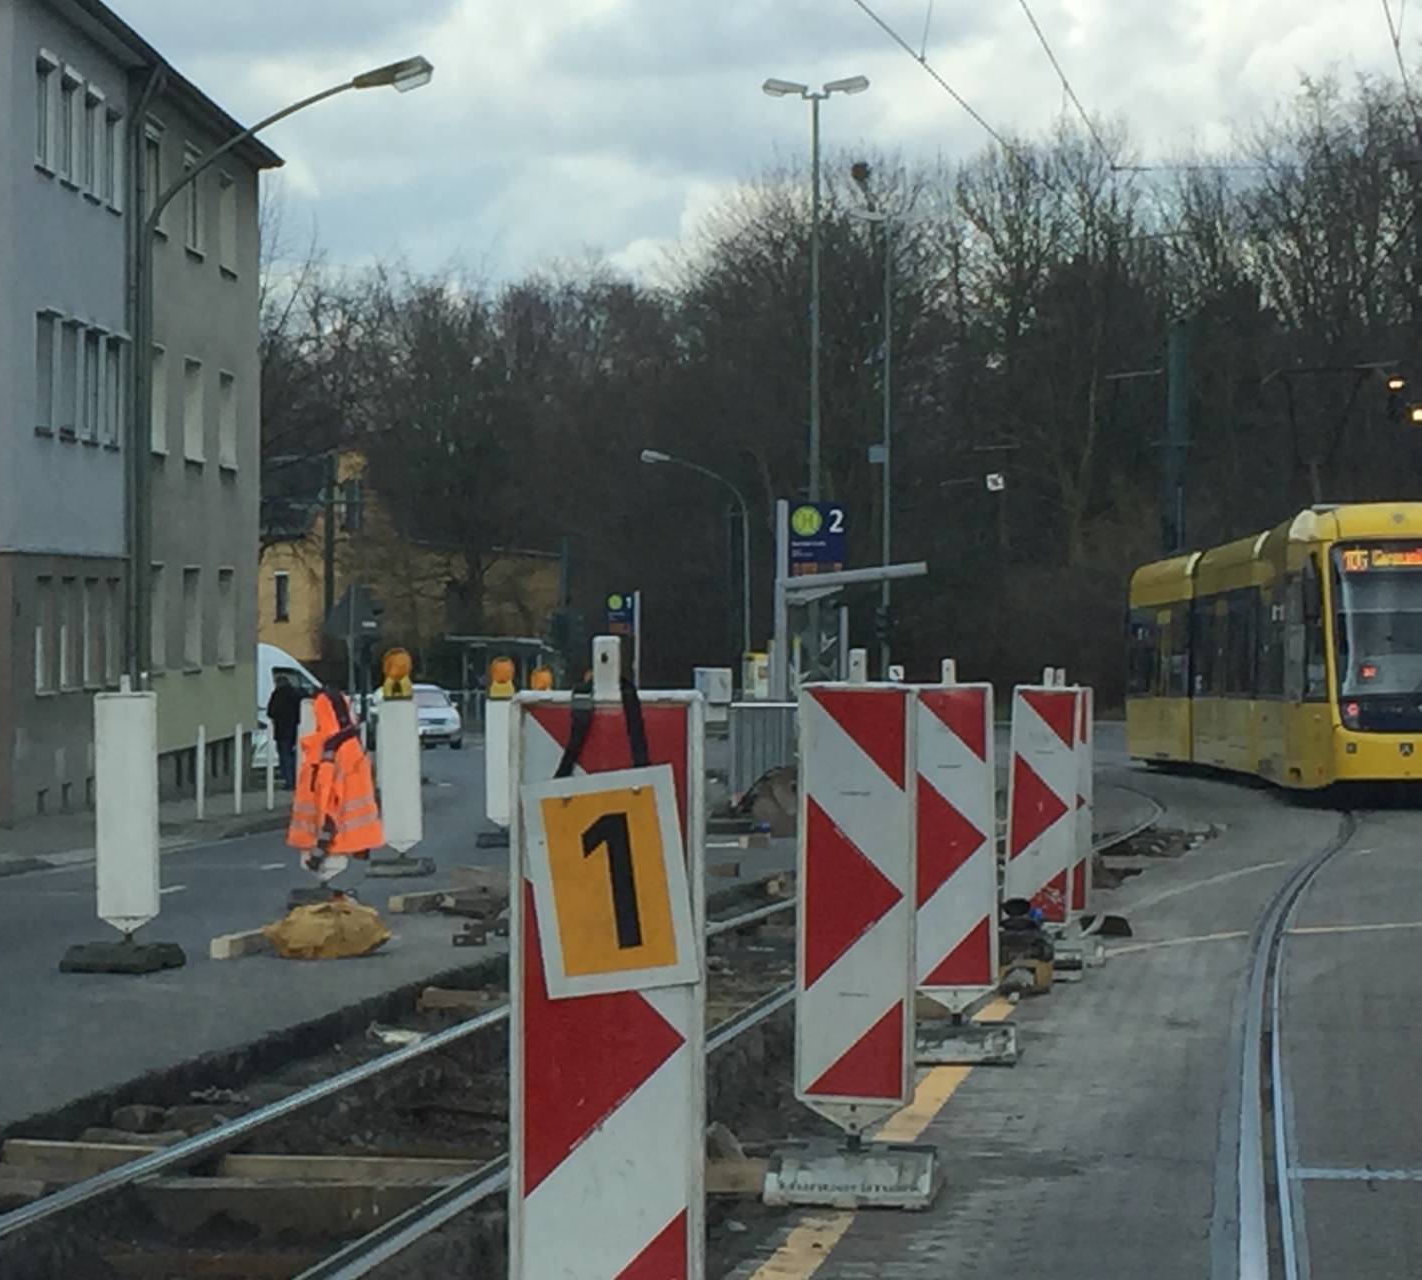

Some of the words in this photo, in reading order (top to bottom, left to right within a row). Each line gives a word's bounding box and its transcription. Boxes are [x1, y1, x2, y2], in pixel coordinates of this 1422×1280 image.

[829, 509, 844, 533] 2
[625, 596, 633, 609] 1
[582, 812, 642, 950] 1
